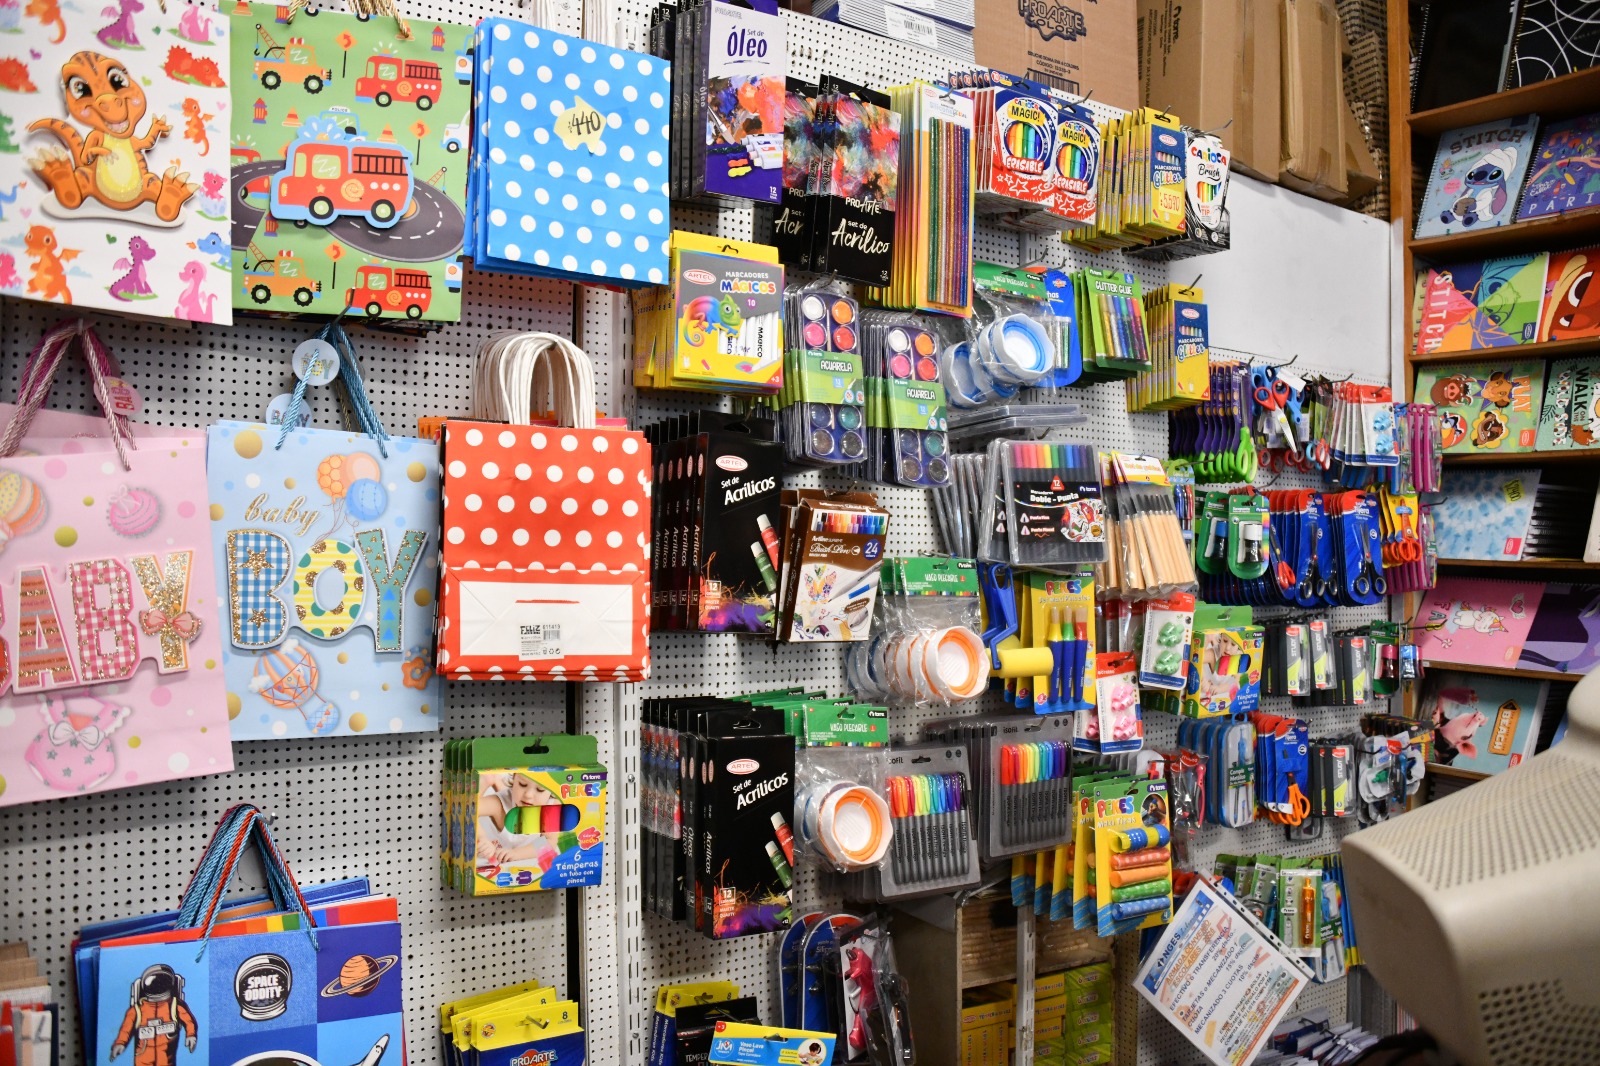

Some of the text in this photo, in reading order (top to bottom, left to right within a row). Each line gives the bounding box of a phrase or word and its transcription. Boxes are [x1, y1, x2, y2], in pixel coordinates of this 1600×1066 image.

[1027, 13, 1076, 35] COLOR
[727, 25, 767, 58] Óleo
[1011, 105, 1040, 122] MAGIC!
[1062, 128, 1086, 144] MAGIC!
[1450, 128, 1528, 155] STITCH
[1006, 156, 1044, 174] ERASABLE
[1198, 163, 1220, 177] Brush
[770, 186, 777, 194] 12
[1058, 177, 1088, 195] ERASABLE
[1201, 208, 1210, 216] TIP
[847, 220, 868, 230] set de
[687, 272, 712, 282] ARTEL
[725, 271, 769, 279] MARCADORES
[720, 278, 776, 295] MÁGICOS
[1095, 281, 1133, 295] GLITTER GLUE
[748, 299, 756, 307] 10
[1424, 273, 1453, 350] STITCH
[820, 360, 853, 373] ACUARELA
[906, 388, 936, 400] ACUARELA
[1512, 375, 1532, 413] PLAY
[1573, 366, 1590, 412] WALK
[1580, 411, 1585, 422] ON
[721, 476, 740, 489] Set de
[1053, 479, 1060, 487] 12
[724, 476, 776, 506] Acrílicos
[1030, 492, 1079, 503] Doble Punta
[244, 492, 320, 537] baby
[831, 544, 850, 555] Pen
[865, 542, 878, 555] 24
[226, 527, 429, 653] BOY
[708, 582, 718, 591] 12
[1045, 579, 1082, 596] PEKES
[0, 550, 194, 696] ABY
[1246, 686, 1250, 694] 6
[1494, 710, 1512, 750] BEACH
[560, 782, 601, 800] PEKES
[732, 779, 752, 794] Set de
[736, 772, 789, 811] Acrílicos
[1097, 796, 1135, 818] PEKES
[573, 850, 582, 862] 6
[555, 859, 599, 871] Témperas
[566, 876, 586, 886] pincel
[723, 889, 732, 899] 12
[1164, 912, 1169, 920] 4
[1211, 946, 1223, 961] 20%
[1168, 923, 1229, 1011] EFECTIVO TRANSFERENCIA
[1171, 943, 1202, 988] ESCOLARES
[1225, 958, 1235, 972] 15%
[246, 974, 280, 989] SPACE
[1238, 969, 1248, 982] 10%
[1181, 989, 1204, 1023] TARJETAS
[1205, 944, 1235, 987] MECANIZADO
[244, 986, 283, 1003] ODDITY
[727, 992, 732, 1000] 8
[1193, 992, 1223, 1035] MECANIZADO
[1224, 962, 1244, 990] CUOTAS
[562, 1011, 568, 1020] 8
[1186, 1004, 1203, 1028] CUOTA
[738, 1046, 755, 1054] Pincel
[511, 1050, 555, 1066] PROARTE
